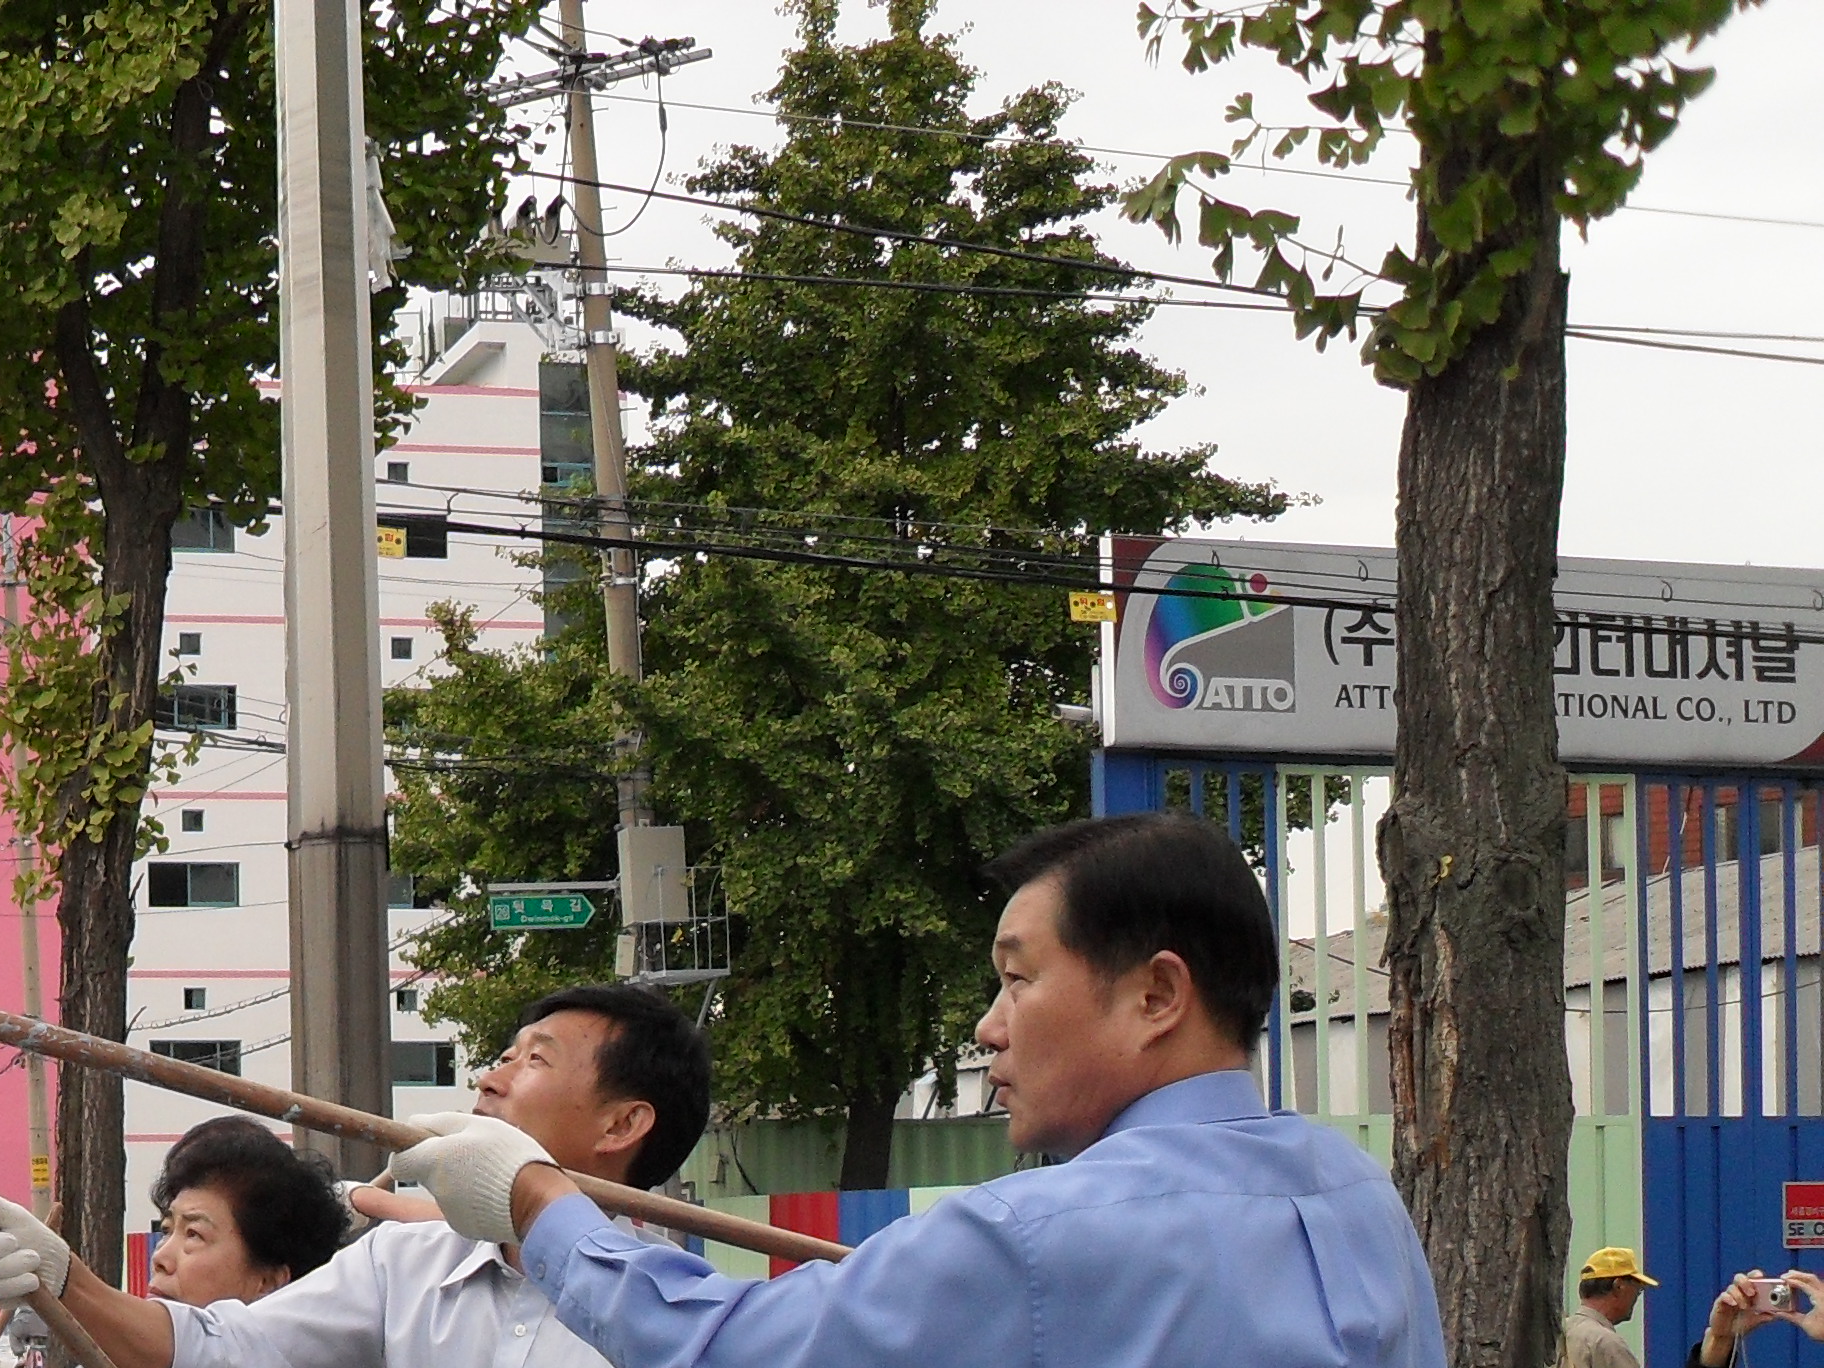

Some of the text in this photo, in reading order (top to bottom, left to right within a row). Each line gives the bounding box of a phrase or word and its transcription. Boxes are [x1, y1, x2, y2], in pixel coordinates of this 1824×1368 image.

[1202, 676, 1295, 711] ATTO
[1334, 683, 1798, 727] ATT TIONAL CO., LTD
